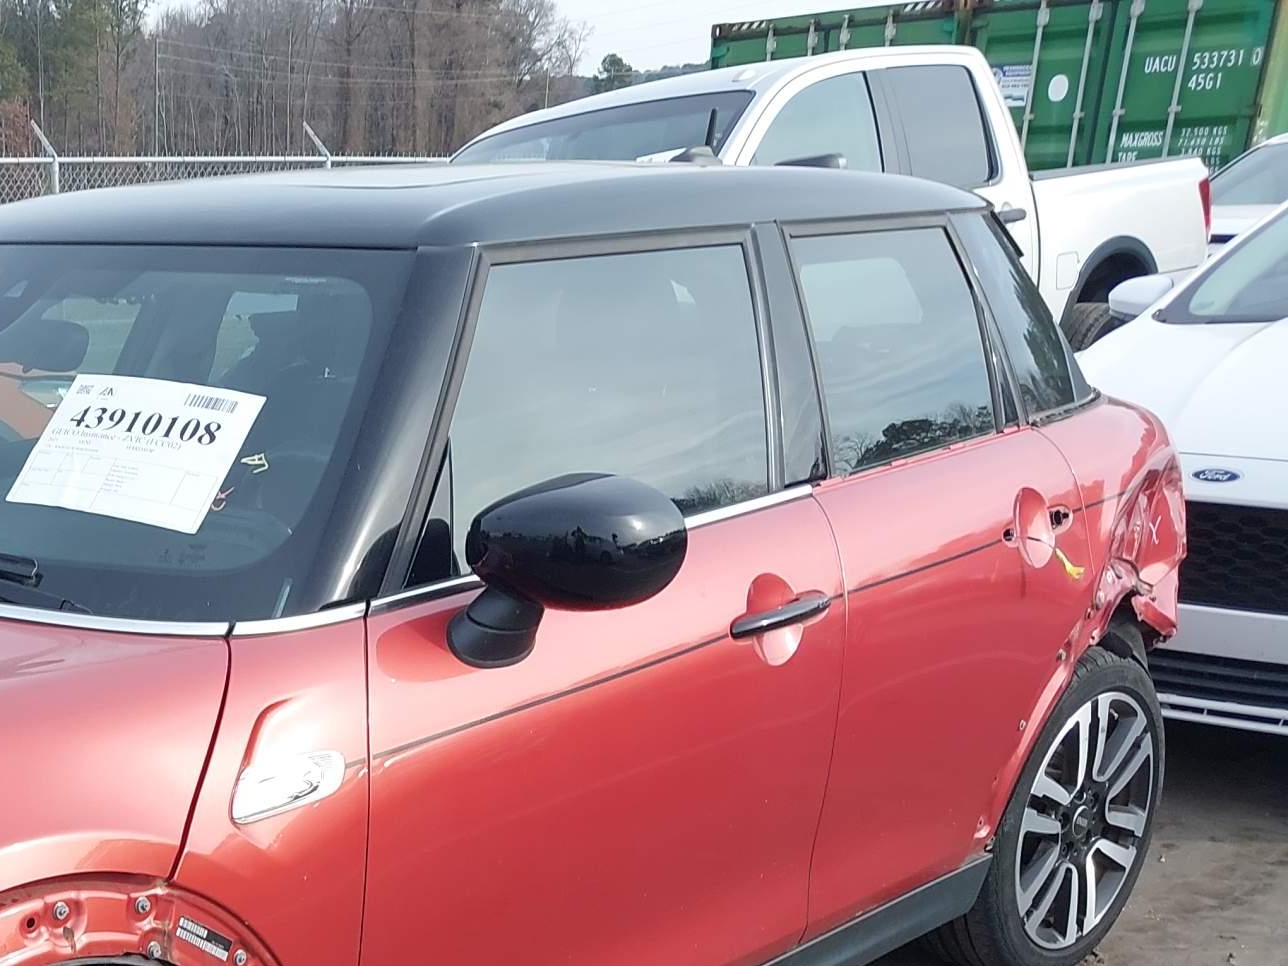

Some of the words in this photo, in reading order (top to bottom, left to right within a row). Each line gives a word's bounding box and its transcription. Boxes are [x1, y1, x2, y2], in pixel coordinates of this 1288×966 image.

[1144, 54, 1176, 73] UACU
[1192, 49, 1244, 70] 533731
[1251, 47, 1263, 65] 0
[1187, 72, 1222, 91] 45G1
[70, 404, 222, 446] 43910108
